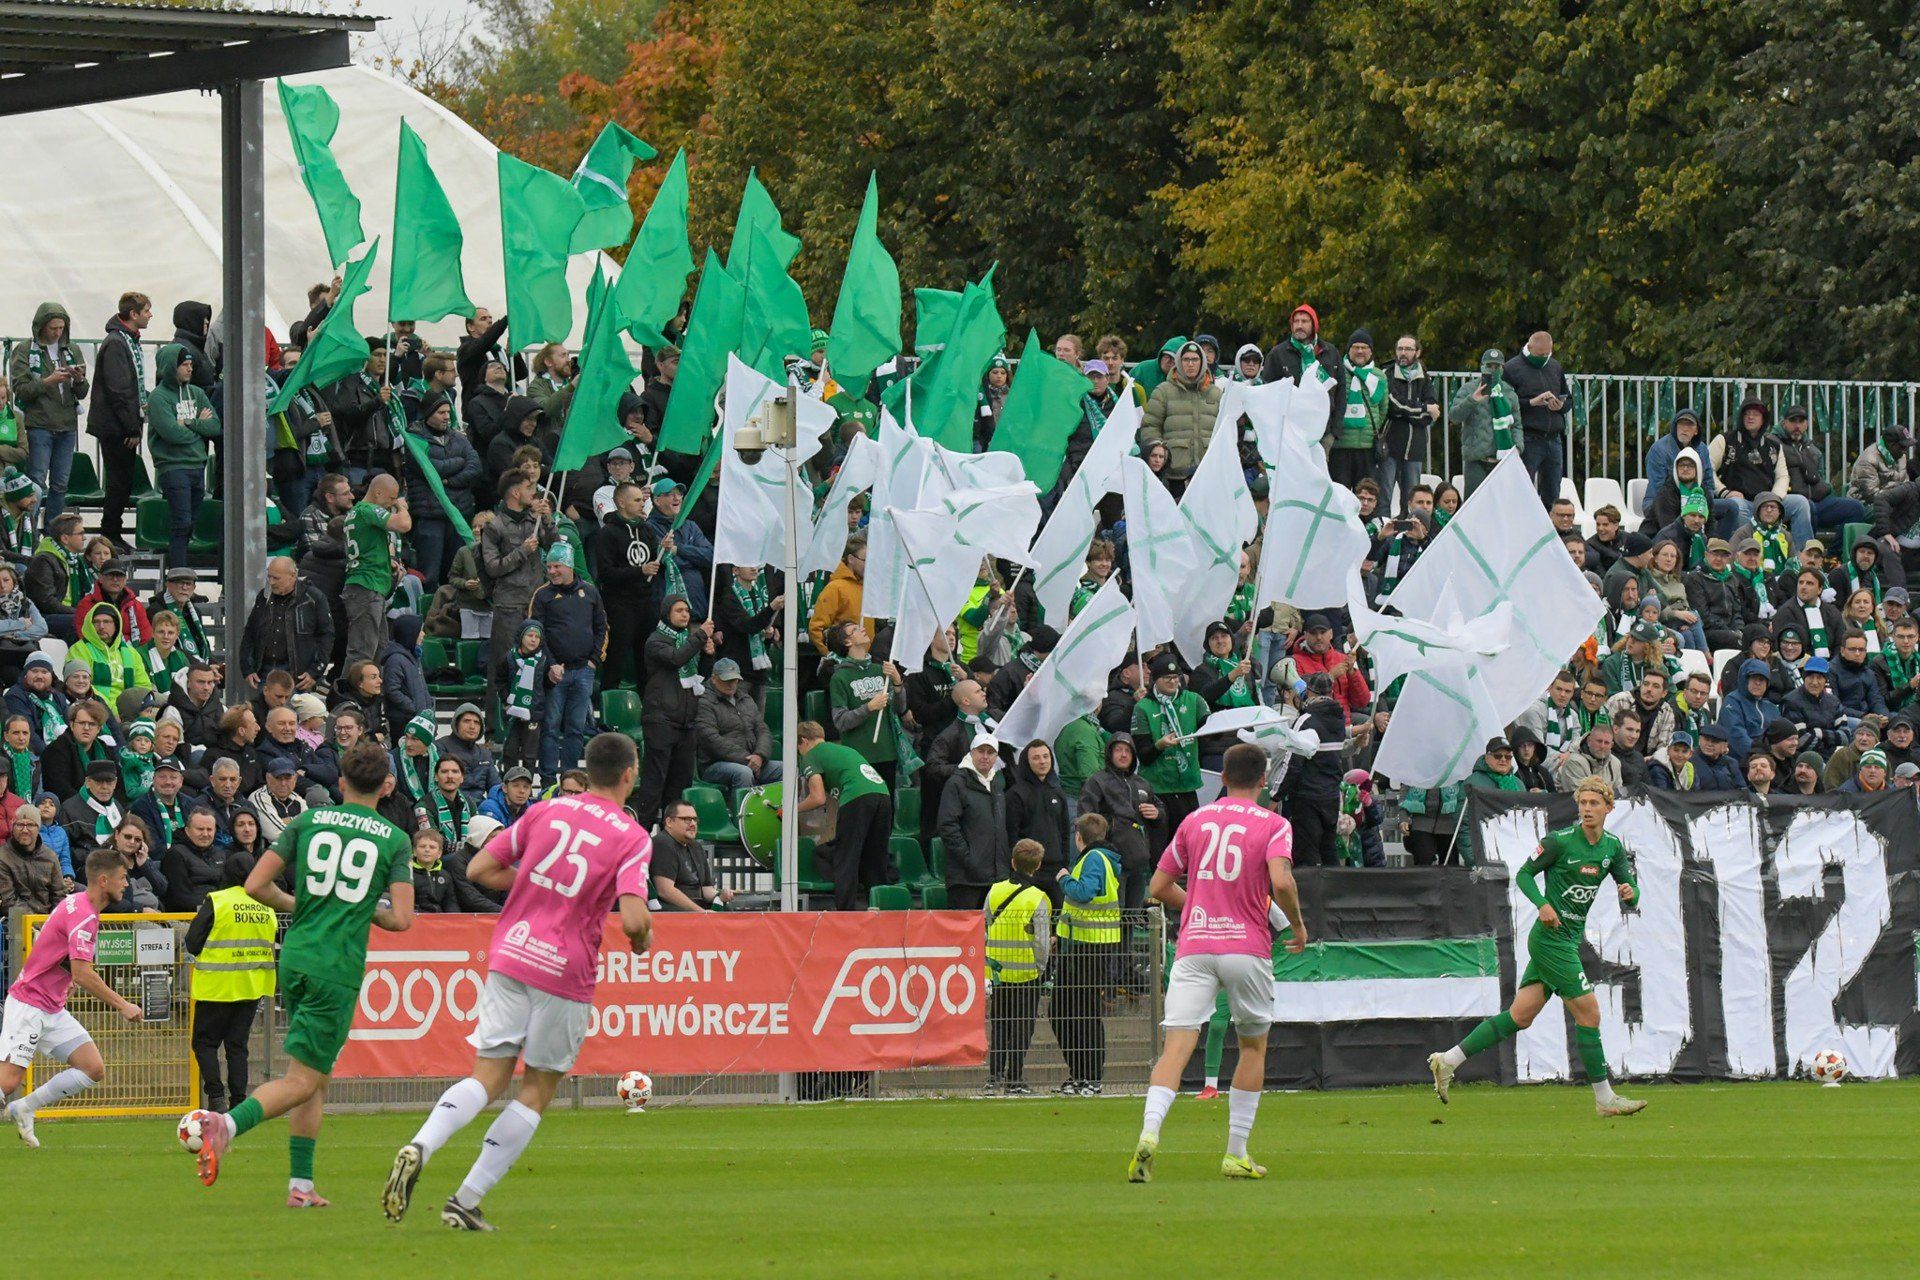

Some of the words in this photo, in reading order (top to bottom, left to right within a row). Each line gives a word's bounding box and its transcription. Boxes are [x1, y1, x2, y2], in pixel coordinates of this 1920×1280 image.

[312, 810, 392, 838] SMOCZYŃSKI
[1197, 821, 1247, 882] 26
[306, 831, 378, 903] 99
[530, 819, 602, 898] 25
[98, 938, 132, 949] WYJŚCIE
[140, 943, 163, 952] STREFA
[166, 942, 170, 950] 2
[348, 950, 486, 1041] ogo
[812, 946, 976, 1035] Fogo
